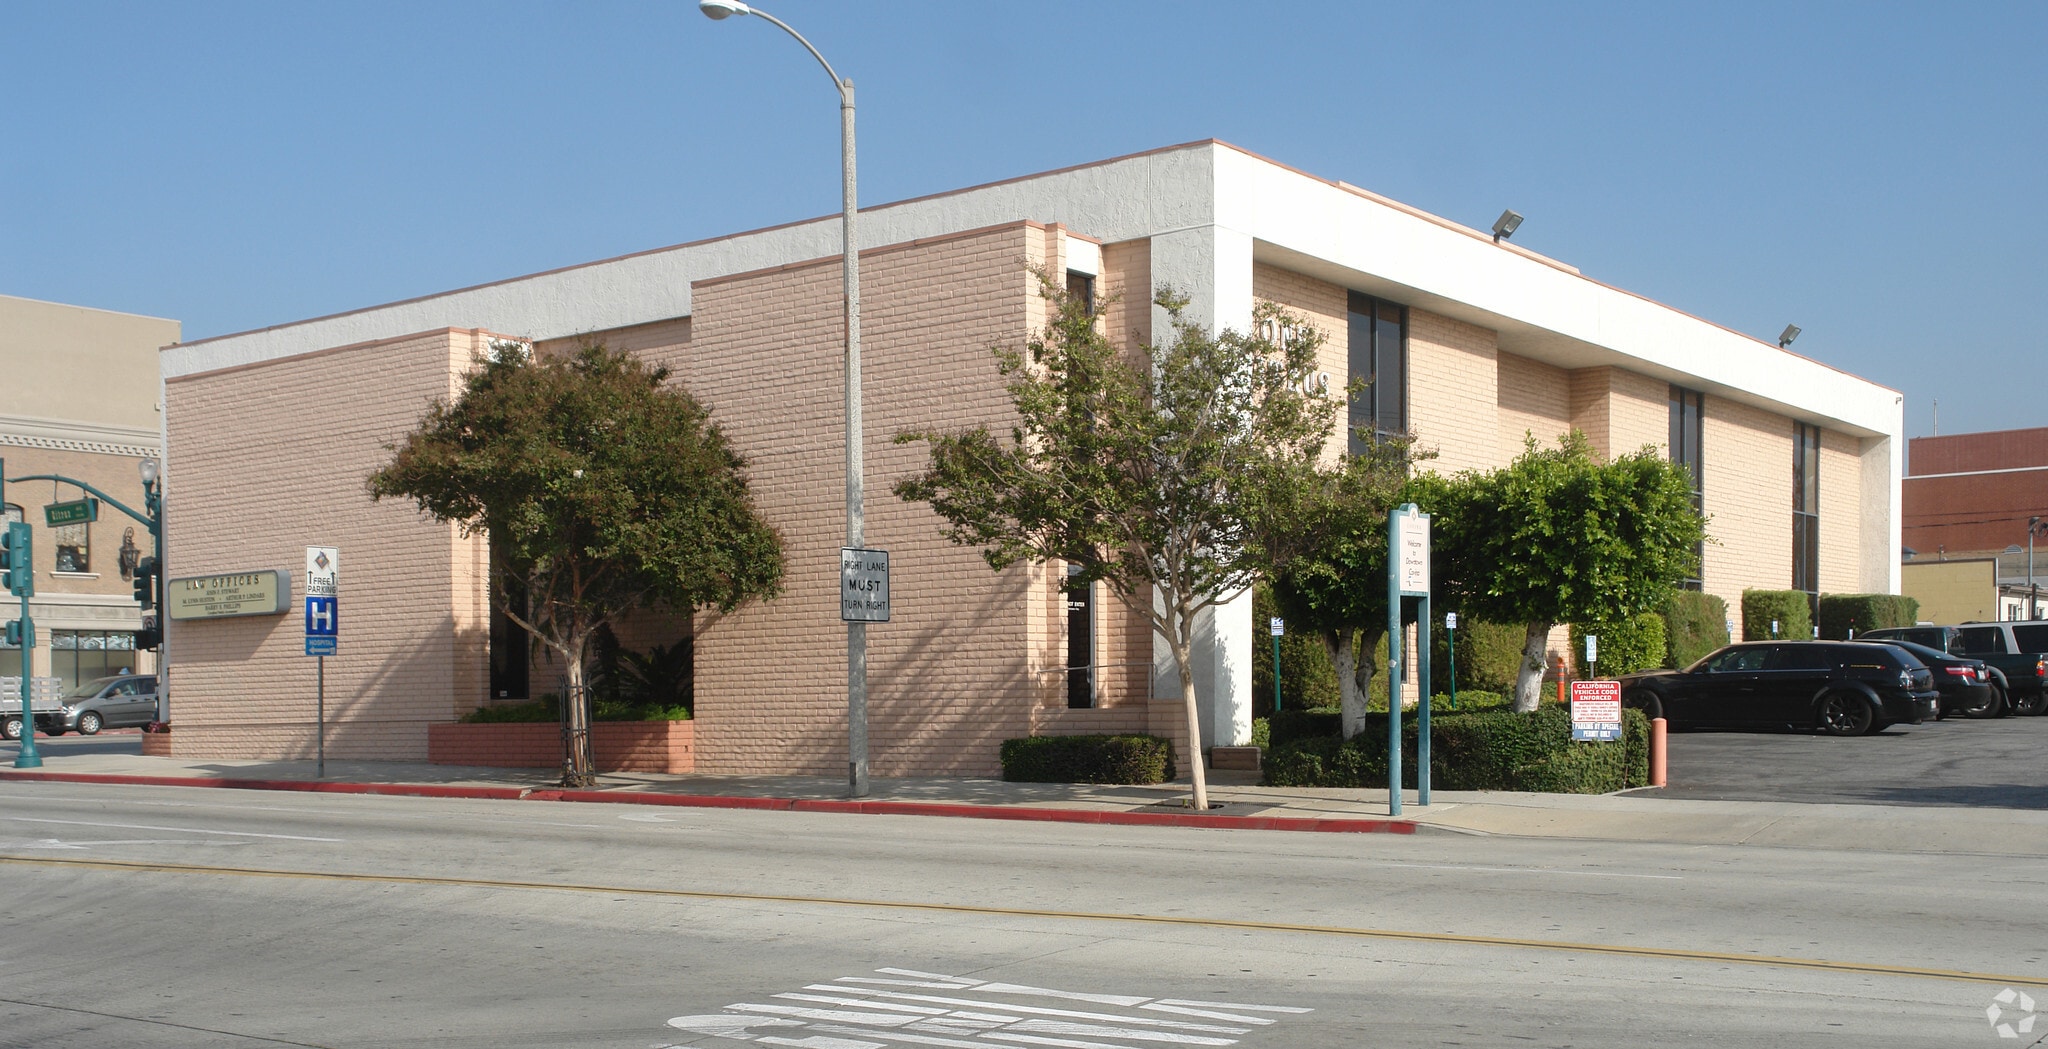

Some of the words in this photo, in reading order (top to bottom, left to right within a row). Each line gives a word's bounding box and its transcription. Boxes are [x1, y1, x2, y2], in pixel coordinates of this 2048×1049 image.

[1407, 540, 1421, 548] Welcome
[844, 560, 862, 571] RIGHT
[866, 562, 885, 572] LANE
[1405, 556, 1422, 566] Downtown
[186, 580, 205, 590] LAW
[212, 575, 260, 588] OFFICES
[313, 577, 330, 585] FREE
[849, 579, 880, 592] MUST
[307, 585, 336, 593] PARKING
[844, 600, 863, 610] TURN
[866, 600, 885, 611] RIGHT
[311, 602, 332, 631] H
[1602, 723, 1619, 731] SPECIAL
